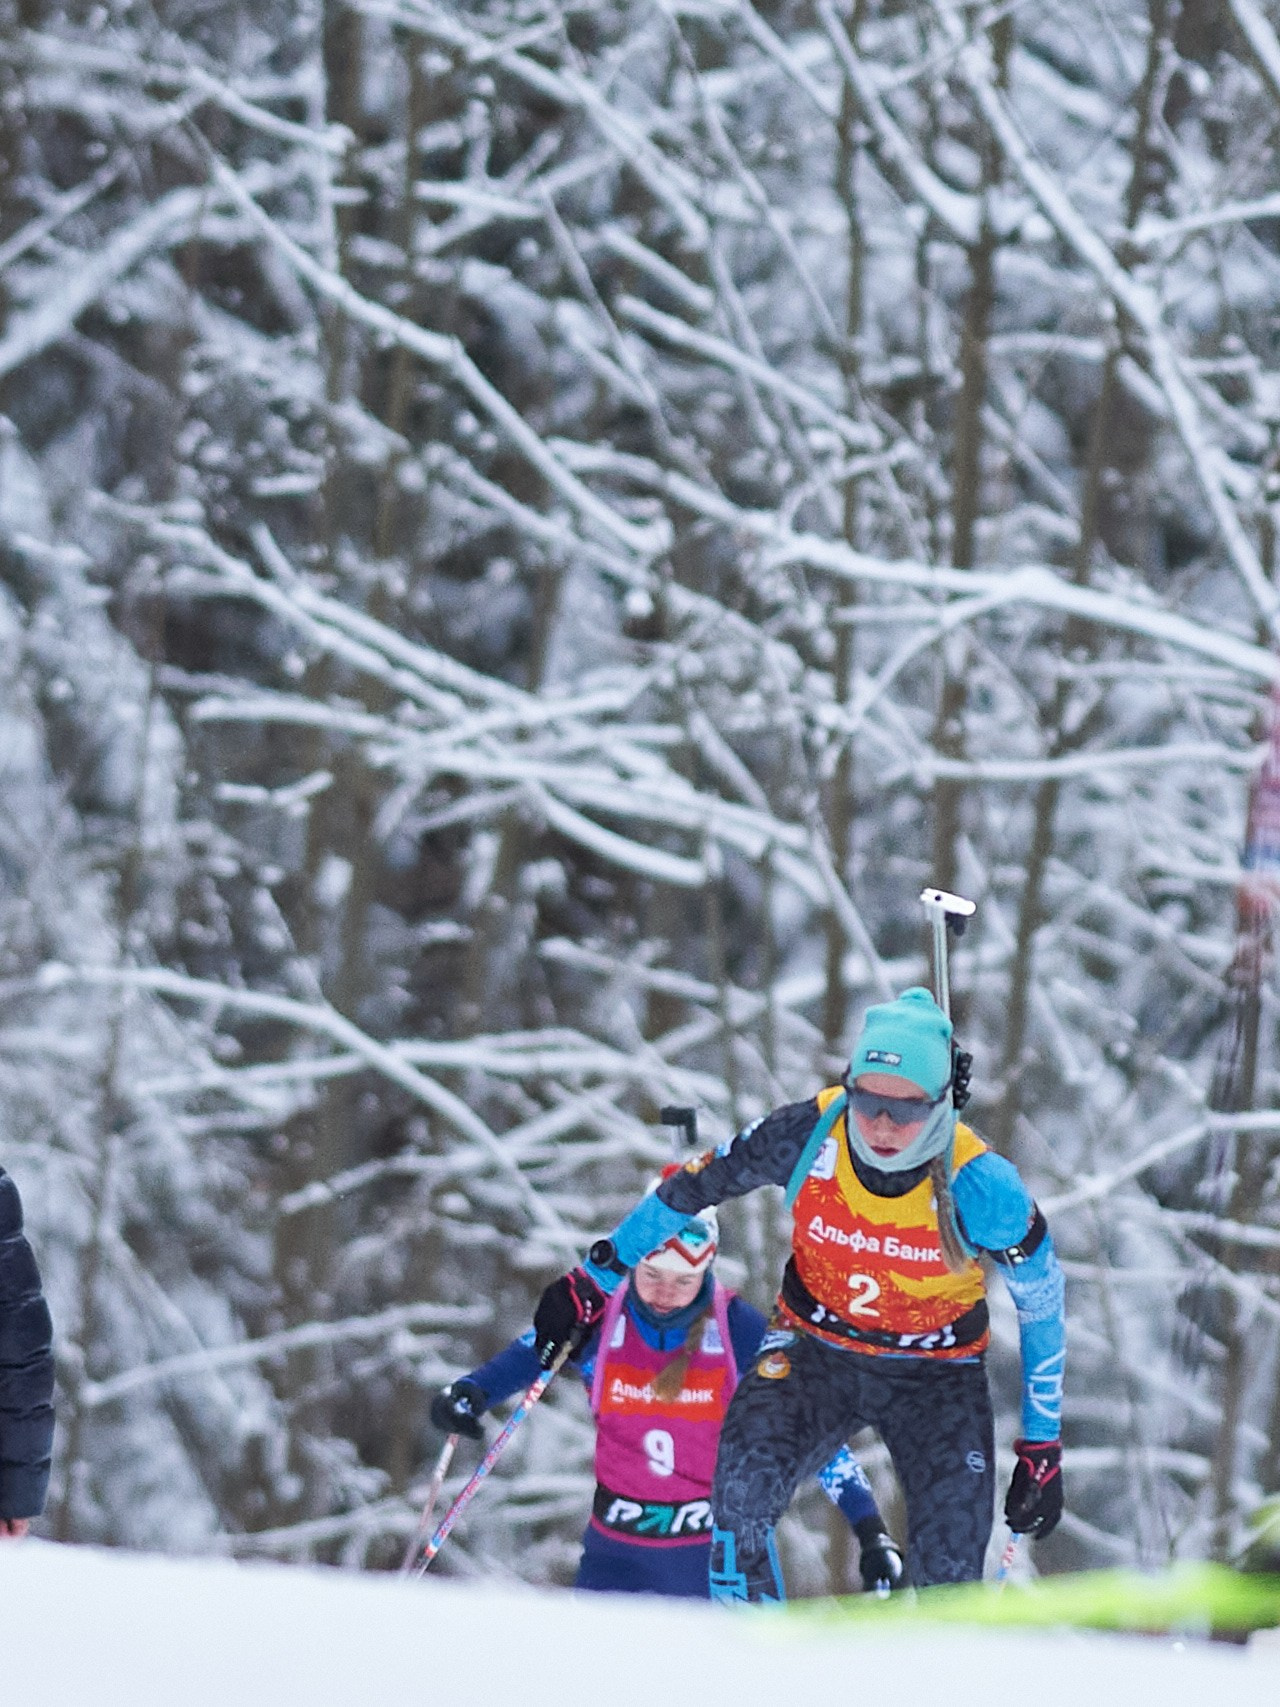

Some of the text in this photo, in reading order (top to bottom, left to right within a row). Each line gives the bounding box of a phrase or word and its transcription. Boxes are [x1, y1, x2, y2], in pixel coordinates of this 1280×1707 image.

[808, 1215, 942, 1262] Альфа Банк
[848, 1273, 880, 1318] 2
[610, 1378, 658, 1403] Альф
[643, 1428, 675, 1477] 9
